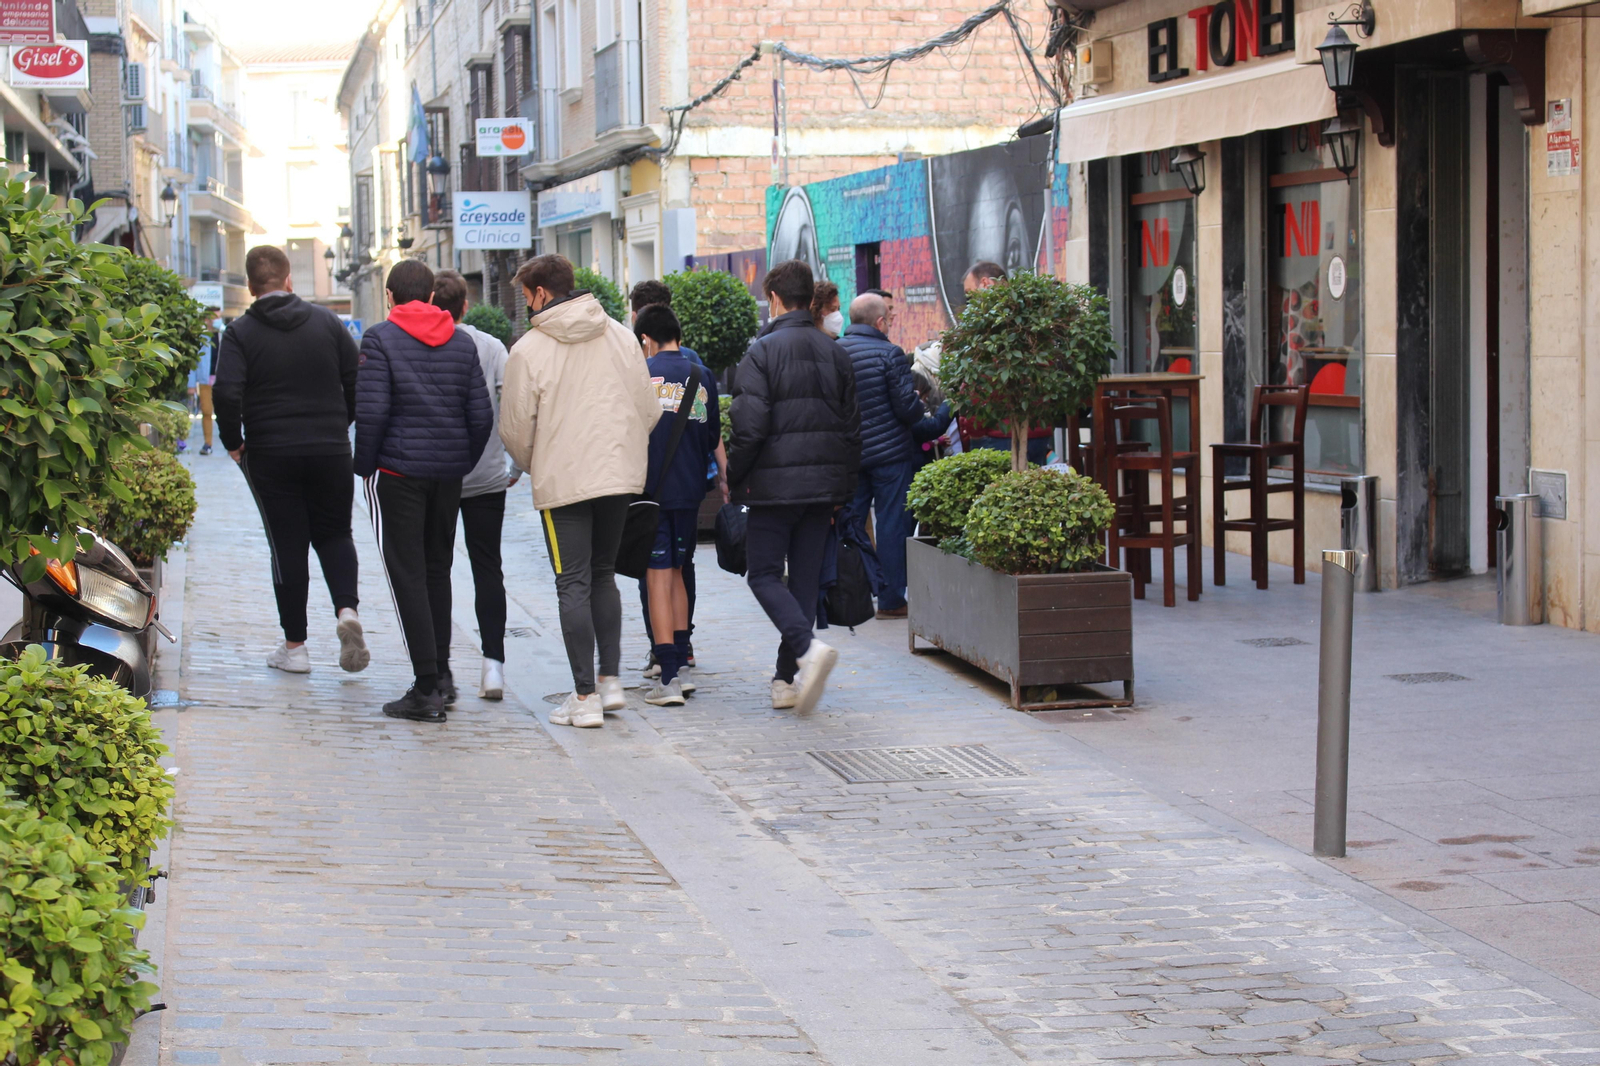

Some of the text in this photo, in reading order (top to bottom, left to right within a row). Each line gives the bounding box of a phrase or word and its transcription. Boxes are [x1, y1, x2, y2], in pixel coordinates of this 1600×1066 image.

[1148, 17, 1189, 83] EL
[479, 122, 523, 134] araceli
[1549, 134, 1570, 144] Alarma
[460, 208, 525, 225] creysade
